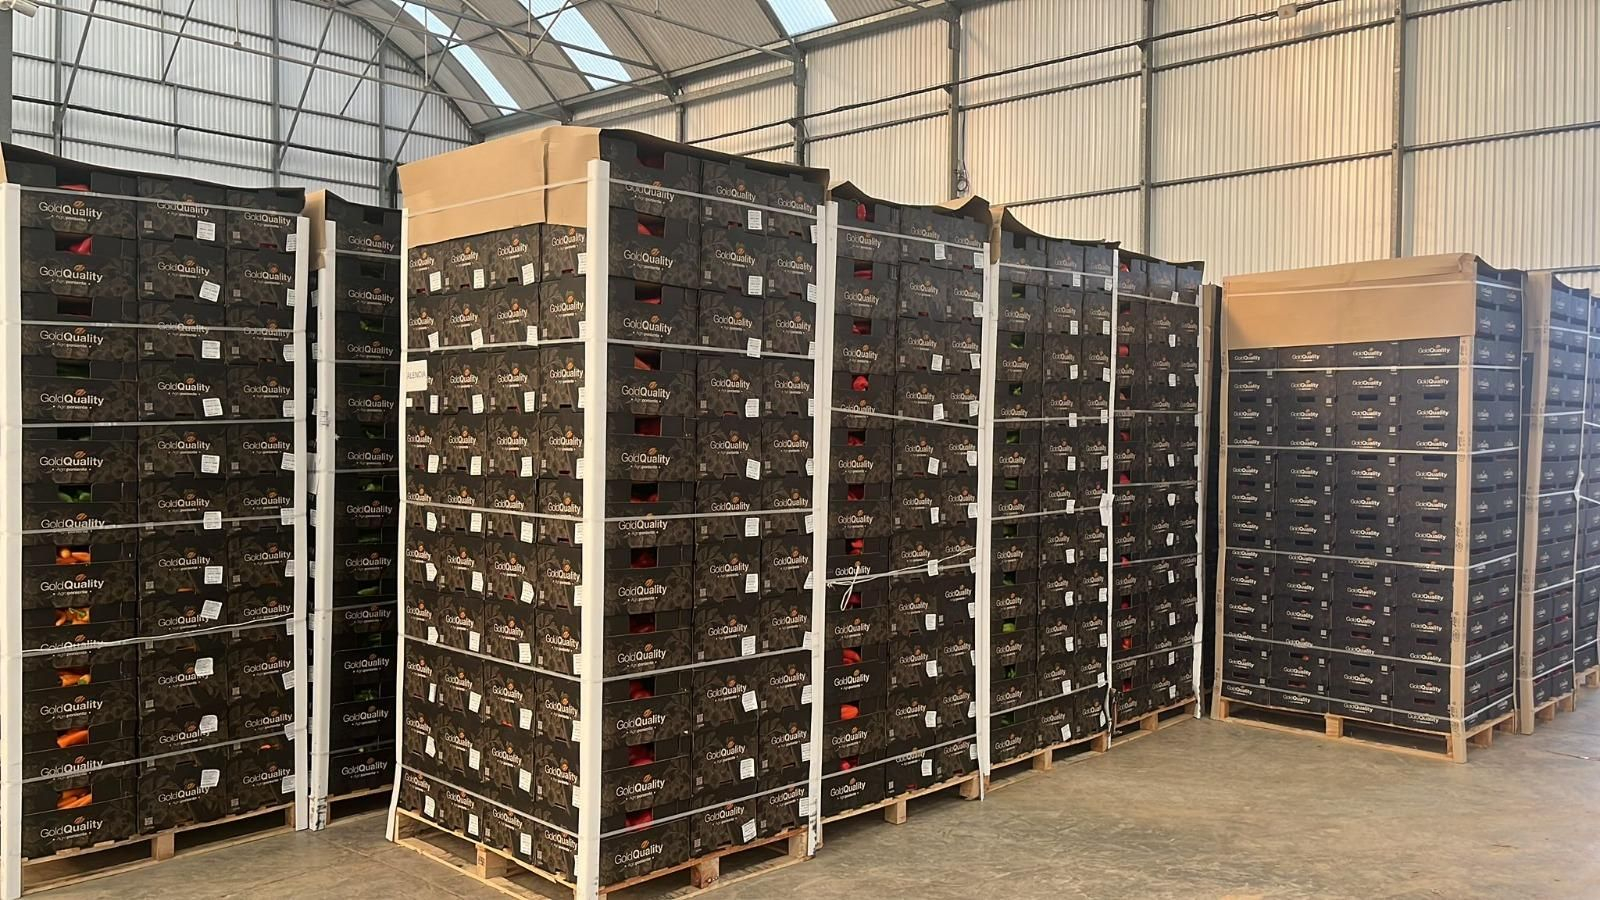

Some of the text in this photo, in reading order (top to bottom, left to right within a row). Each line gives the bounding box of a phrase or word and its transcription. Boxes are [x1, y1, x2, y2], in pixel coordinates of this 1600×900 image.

[716, 185, 755, 202] GoldQuality
[38, 202, 102, 219] GoldQuality
[244, 211, 290, 226] GoldQuality
[348, 235, 394, 251] GoldQuality
[551, 233, 584, 246] GoldQuality
[497, 243, 528, 255] GoldQuality
[623, 249, 673, 268] GoldQuality
[715, 249, 755, 266] GoldQuality
[157, 262, 210, 276] GoldQuality
[777, 258, 813, 273] GoldQuality
[39, 266, 103, 283] GoldQuality
[244, 270, 292, 282] GoldQuality
[910, 282, 938, 295] GoldQuality
[348, 289, 394, 303] GoldQuality
[844, 291, 879, 305] GoldQuality
[496, 308, 527, 319] GoldQuality
[549, 301, 583, 313] GoldQuality
[623, 318, 672, 333] GoldQuality
[713, 314, 753, 328] GoldQuality
[775, 318, 811, 332] GoldQuality
[39, 332, 103, 344] GoldQuality
[908, 337, 936, 348] GoldQuality
[347, 344, 393, 355] GoldQuality
[843, 348, 878, 360] GoldQuality
[497, 373, 527, 383] GoldQuality
[549, 368, 583, 378] GoldQuality
[157, 381, 210, 392] GoldQuality
[244, 385, 290, 395] GoldQuality
[710, 378, 750, 390] GoldQuality
[774, 380, 810, 391] GoldQuality
[40, 392, 104, 406] GoldQuality
[621, 385, 670, 400] GoldQuality
[906, 391, 935, 401] GoldQuality
[348, 398, 394, 409] GoldQuality
[157, 440, 210, 451] GoldQuality
[243, 441, 290, 450] GoldQuality
[496, 436, 527, 447] GoldQuality
[548, 435, 582, 448] GoldQuality
[710, 440, 749, 451] GoldQuality
[773, 439, 808, 449] GoldQuality
[904, 444, 933, 454] GoldQuality
[39, 456, 103, 468] GoldQuality
[347, 451, 393, 462] GoldQuality
[621, 452, 670, 465] GoldQuality
[838, 459, 873, 470] GoldQuality
[158, 498, 210, 508] GoldQuality
[243, 496, 291, 505] GoldQuality
[494, 498, 524, 511] GoldQuality
[710, 502, 750, 511] GoldQuality
[774, 497, 809, 507] GoldQuality
[903, 497, 932, 506] GoldQuality
[347, 504, 392, 514] GoldQuality
[547, 501, 580, 515] GoldQuality
[41, 518, 105, 529] GoldQuality
[618, 518, 668, 530] GoldQuality
[838, 514, 873, 524] GoldQuality
[244, 551, 291, 561] GoldQuality
[773, 555, 808, 566] GoldQuality
[901, 550, 931, 558] GoldQuality
[158, 556, 211, 567] GoldQuality
[345, 557, 391, 566] GoldQuality
[494, 561, 525, 574] GoldQuality
[709, 562, 749, 573] GoldQuality
[546, 567, 580, 582] GoldQuality
[40, 579, 104, 591] GoldQuality
[618, 584, 667, 596] GoldQuality
[899, 602, 928, 610] GoldQuality
[345, 609, 390, 619] GoldQuality
[772, 614, 807, 626] GoldQuality
[493, 623, 524, 638] GoldQuality
[708, 623, 747, 636] GoldQuality
[834, 623, 870, 634] GoldQuality
[545, 633, 578, 650] GoldQuality
[617, 648, 666, 663] GoldQuality
[243, 660, 291, 673] GoldQuality
[344, 658, 389, 669] GoldQuality
[769, 672, 806, 685] GoldQuality
[834, 674, 869, 686] GoldQuality
[492, 684, 522, 701] GoldQuality
[706, 684, 747, 698] GoldQuality
[40, 700, 103, 714] GoldQuality
[544, 699, 578, 717] GoldQuality
[896, 704, 925, 715] GoldQuality
[245, 714, 292, 727] GoldQuality
[343, 709, 389, 722] GoldQuality
[616, 713, 666, 730] GoldQuality
[771, 730, 807, 744] GoldQuality
[832, 730, 867, 744] GoldQuality
[492, 747, 521, 766] GoldQuality
[706, 745, 745, 760] GoldQuality
[40, 759, 103, 777] GoldQuality
[341, 761, 387, 775] GoldQuality
[544, 763, 578, 784] GoldQuality
[243, 768, 291, 784] GoldQuality
[158, 785, 210, 802] GoldQuality
[616, 779, 665, 796] GoldQuality
[830, 782, 865, 796] GoldQuality
[769, 788, 804, 804] GoldQuality
[704, 806, 744, 822] GoldQuality
[40, 821, 103, 837] GoldQuality
[544, 829, 578, 850] GoldQuality
[614, 844, 663, 864] GoldQuality
